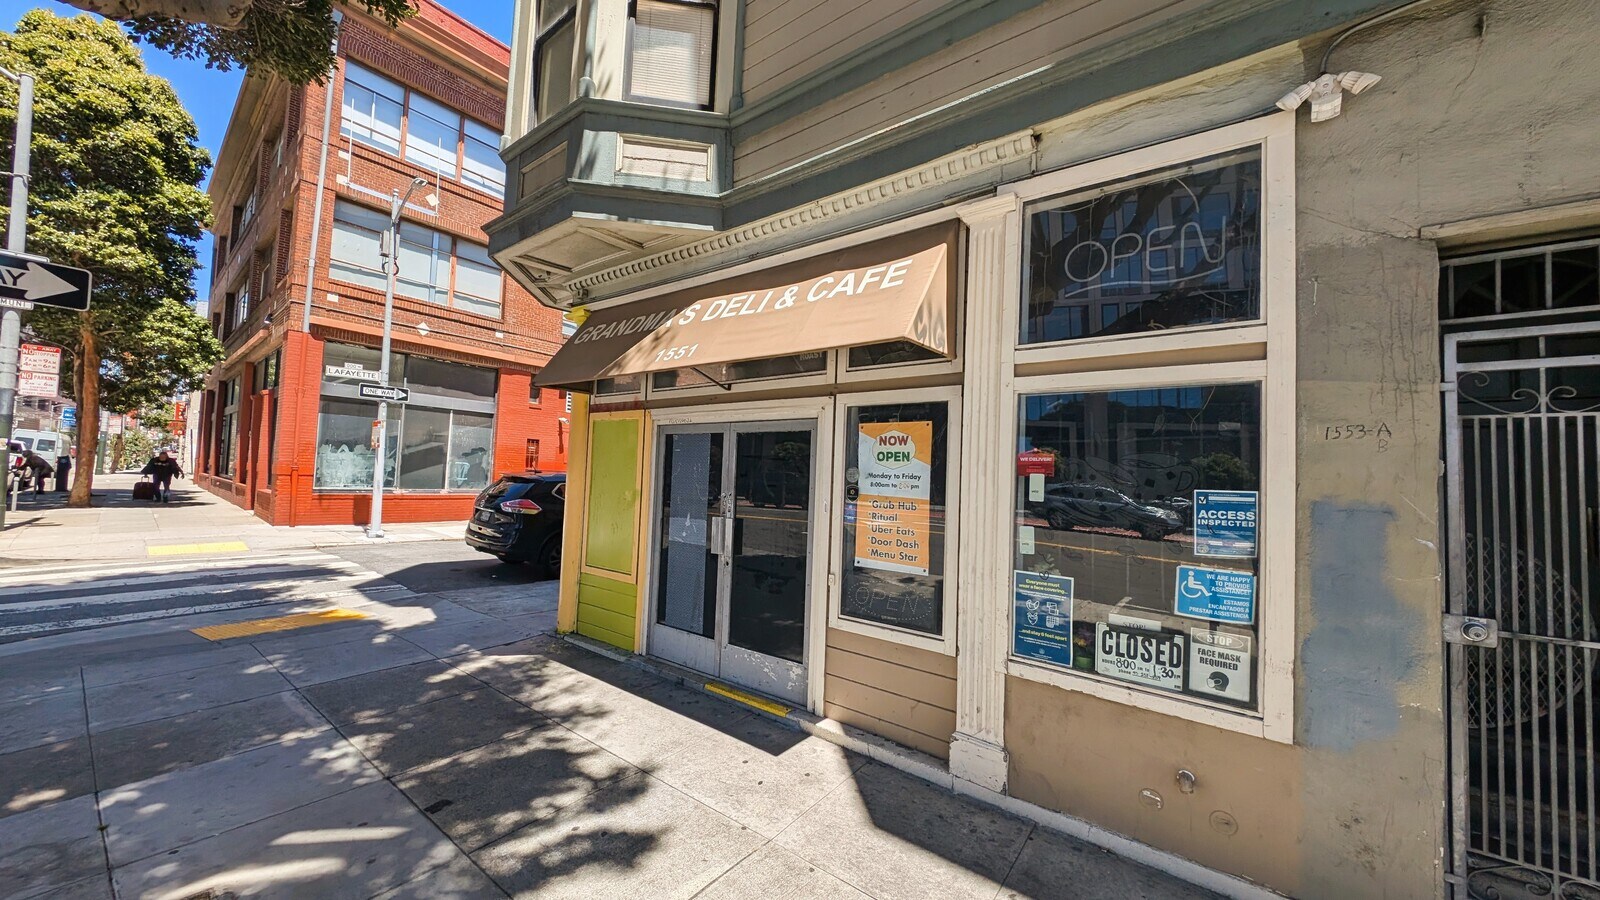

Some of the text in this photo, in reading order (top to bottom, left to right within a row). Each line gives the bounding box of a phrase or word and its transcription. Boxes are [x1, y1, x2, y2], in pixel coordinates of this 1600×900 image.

[1065, 215, 1226, 283] OPEN
[701, 291, 774, 322] DELI
[774, 285, 799, 310] &
[806, 259, 914, 302] CAFE
[654, 343, 700, 363] 1551
[328, 367, 377, 379] LAFAYETTE
[1325, 422, 1392, 440] 1553-A
[879, 436, 909, 446] NOW
[1377, 438, 1388, 453] B
[877, 451, 911, 462] OPEN
[868, 472, 893, 480] Monday
[901, 473, 922, 481] Friday
[871, 500, 917, 511] Grub Hub
[871, 512, 898, 522] Ritual
[1198, 509, 1256, 520] ACCESS
[1197, 519, 1256, 528] INSPECTED
[871, 524, 916, 537] Uber Eats
[870, 536, 920, 550] Door Dash
[870, 548, 919, 562] Menu Star
[1025, 578, 1048, 586] Everyone
[1224, 581, 1250, 589] PROVIDE
[1230, 576, 1251, 584] HAPPY
[856, 587, 919, 615] OPEN
[1223, 599, 1250, 607] ESTAMOS
[1188, 606, 1213, 615] PRESTAR
[1208, 603, 1245, 612] ENCANTADOS
[1206, 634, 1233, 646] STOP
[1101, 629, 1182, 669] CLOSED
[1197, 647, 1242, 664] FACE MASK
[1199, 656, 1239, 671] REQUIRED
